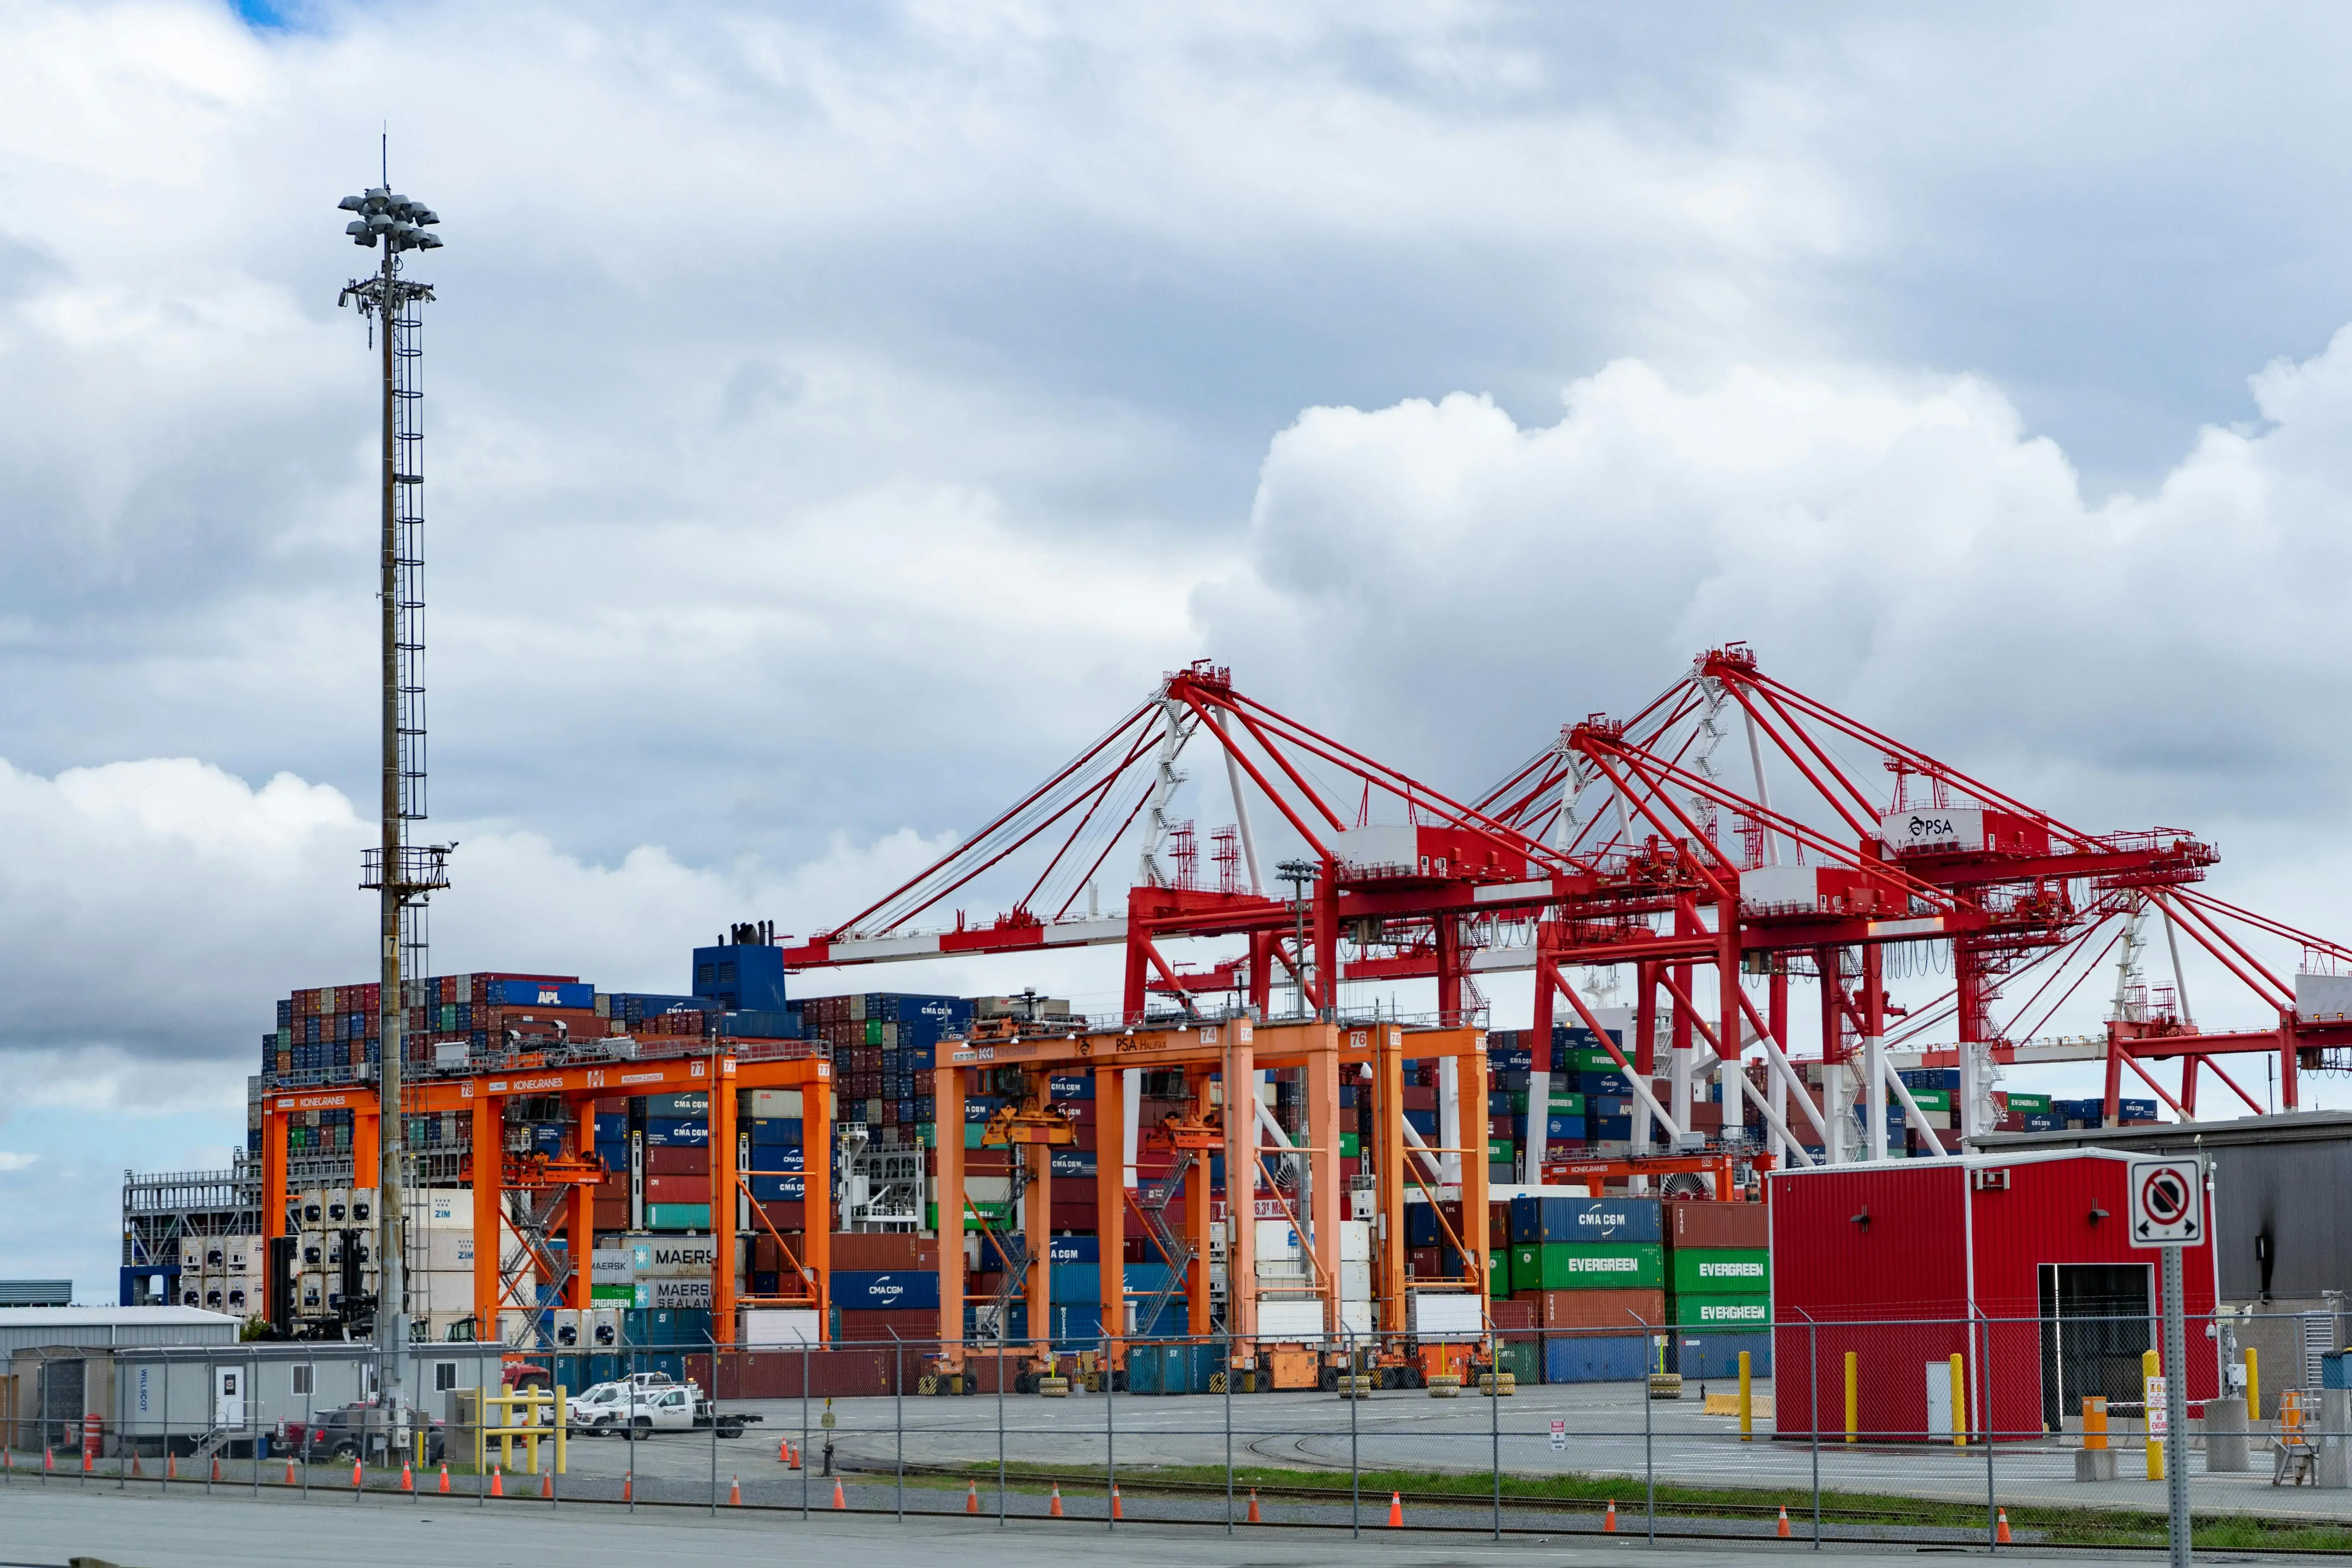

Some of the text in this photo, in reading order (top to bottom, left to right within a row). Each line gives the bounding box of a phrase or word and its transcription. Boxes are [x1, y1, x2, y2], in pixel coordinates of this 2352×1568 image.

[1926, 819, 1953, 835] PSA
[537, 991, 561, 1004] APL
[1202, 1028, 1215, 1041] 74
[1242, 1029, 1252, 1039] 74
[1351, 1033, 1366, 1045] 76
[1391, 1034, 1401, 1043] 76
[1116, 1038, 1137, 1052] PSA
[1476, 1039, 1486, 1048] 76
[725, 1061, 735, 1070] 77
[1592, 1056, 1616, 1064] EVERGR
[692, 1062, 703, 1074] 77
[819, 1066, 829, 1074] 77
[513, 1078, 563, 1090] KONECRANES
[463, 1084, 473, 1096] 78
[300, 1096, 345, 1107] KONECRANES
[1254, 1201, 1270, 1215] 6.3t
[435, 1210, 450, 1218] ZIM
[1579, 1214, 1625, 1225] CMA CGM
[458, 1251, 473, 1259] ZIM
[656, 1250, 711, 1264] MAERS
[1058, 1249, 1078, 1259] CGM
[1569, 1258, 1638, 1271] EVERGREEN
[1699, 1263, 1763, 1276] EVERGREEN
[658, 1284, 709, 1296] MAERS
[869, 1286, 903, 1294] CMA CGM
[591, 1299, 630, 1308] ERGREEN
[658, 1299, 711, 1308] SEALAN
[1701, 1306, 1765, 1319] EVERGREEN
